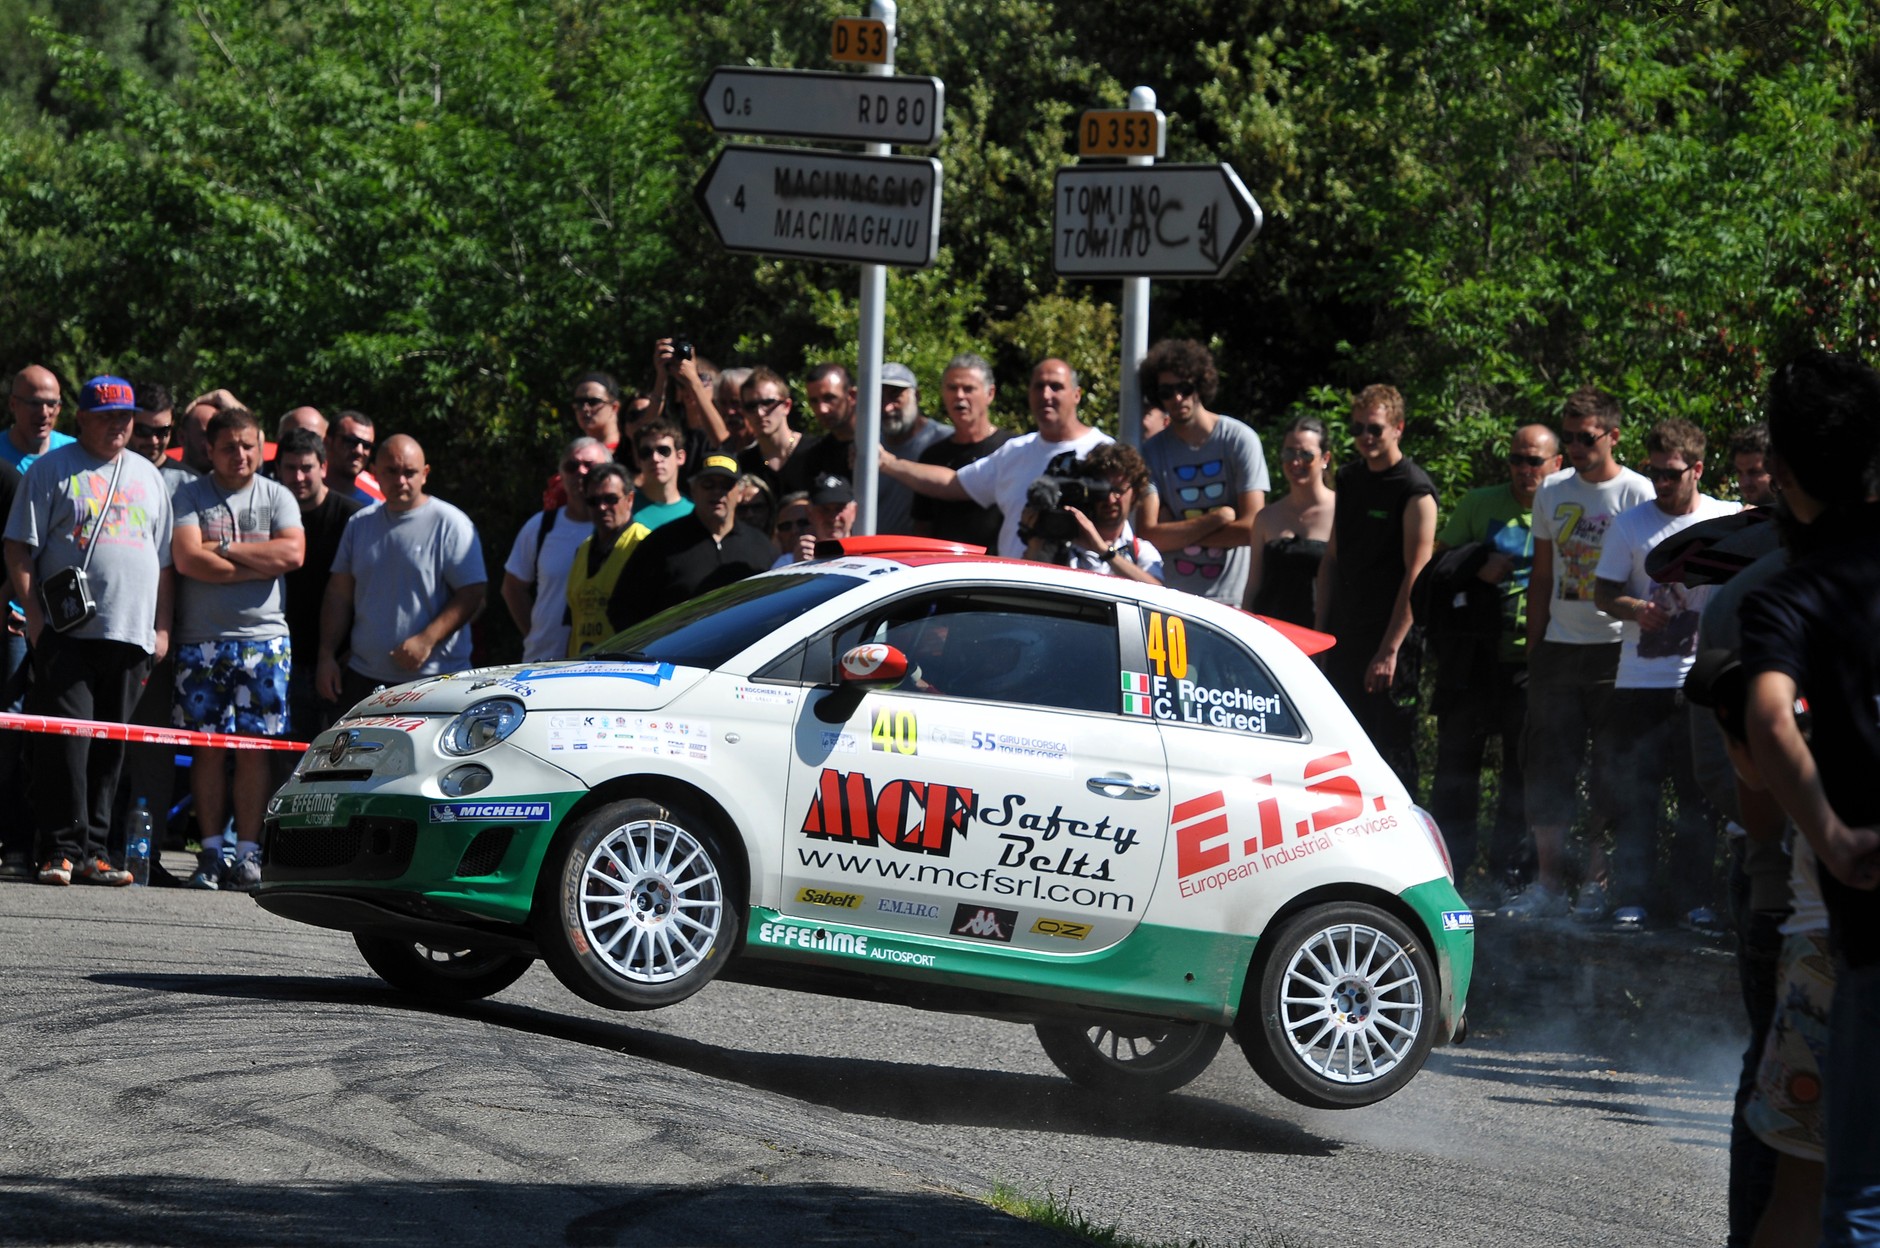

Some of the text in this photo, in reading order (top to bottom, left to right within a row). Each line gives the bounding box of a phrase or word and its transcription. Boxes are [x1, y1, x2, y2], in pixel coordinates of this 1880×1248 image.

[837, 26, 883, 56] D 53
[1088, 119, 1150, 148] D 353
[734, 185, 746, 213] 4
[775, 167, 925, 207] MACINAGGIO
[1064, 186, 1160, 215] TOMINO
[774, 209, 919, 248] MACINAGHJU
[1147, 612, 1188, 680] 40
[1154, 676, 1280, 715] F. Rocchieri
[872, 706, 918, 756] 40
[1155, 698, 1267, 733] C. Li Greci
[971, 731, 996, 752] 55
[1000, 734, 1067, 752] GIRU DI CORSICA
[459, 805, 545, 818] MICHELIN
[801, 768, 979, 858] MCF
[980, 795, 1140, 855] Safety
[998, 833, 1116, 882] Belts
[1179, 860, 1259, 899] European
[1262, 836, 1333, 871] Industrial
[798, 847, 1134, 913] www.mcfsrl.com
[802, 889, 858, 908] Sabelt
[759, 922, 936, 967] EFFEMME AUTOSPORT
